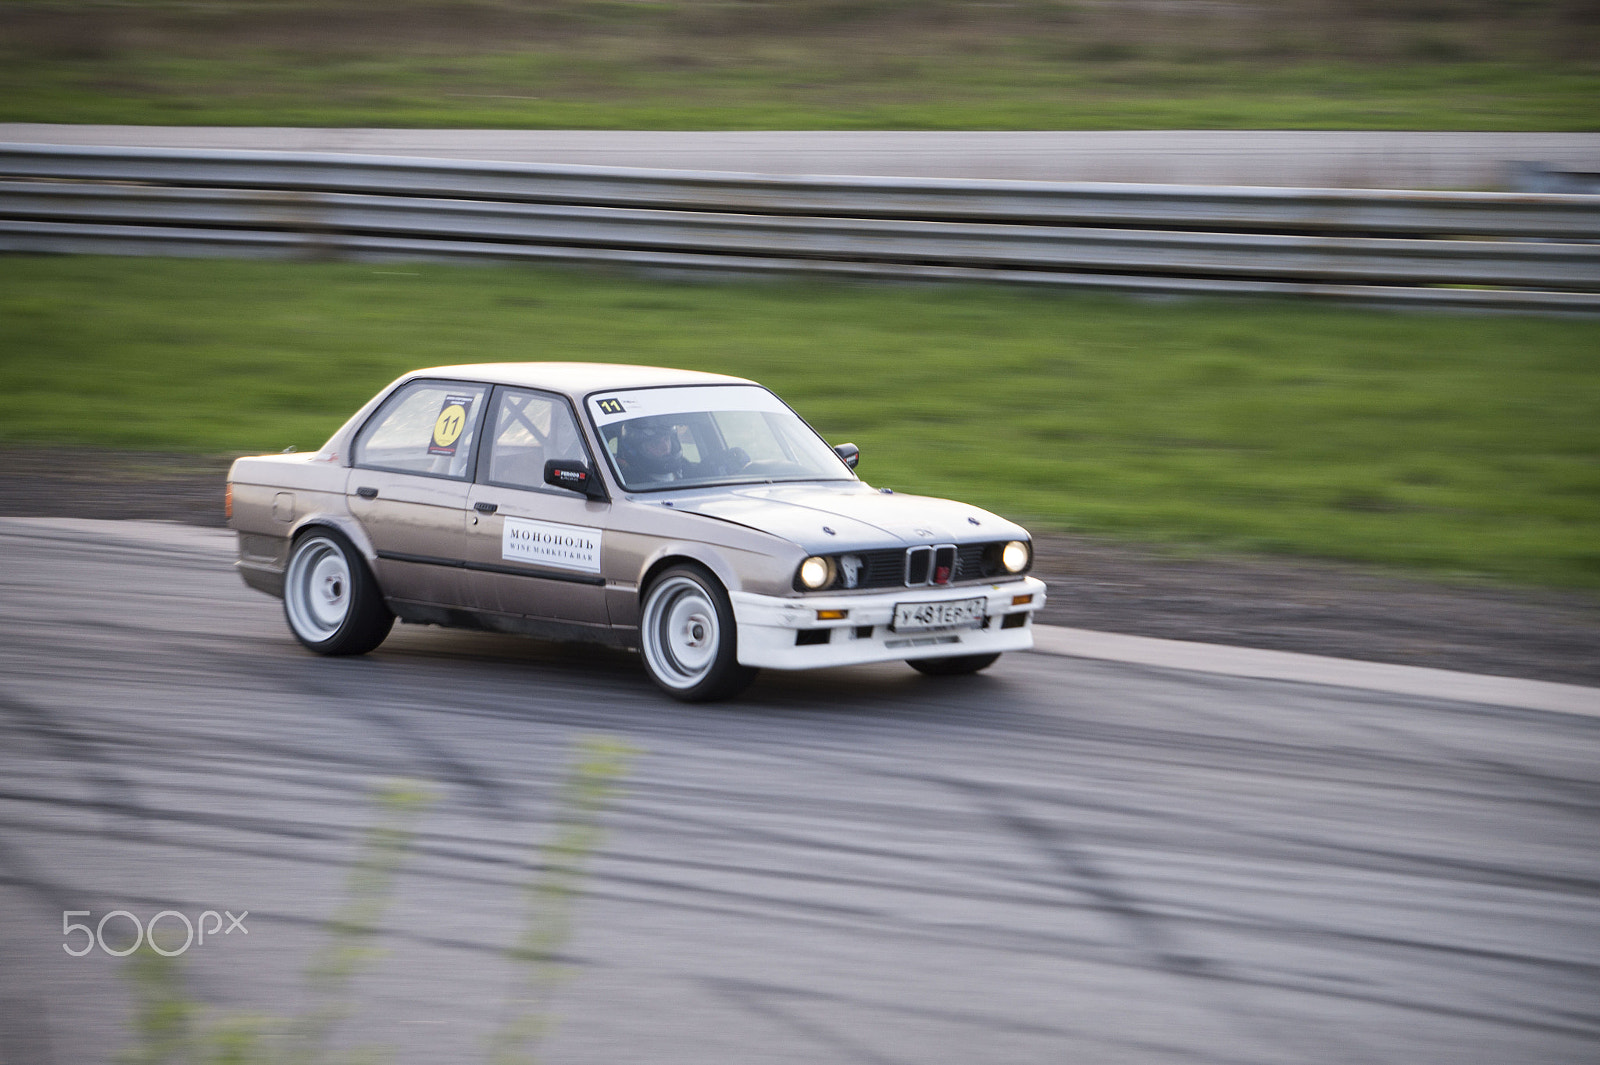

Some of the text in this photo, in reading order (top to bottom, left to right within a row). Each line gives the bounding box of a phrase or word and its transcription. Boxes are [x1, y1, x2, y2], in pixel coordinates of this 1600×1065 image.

[601, 400, 621, 412] 11
[442, 415, 460, 436] 11
[510, 529, 594, 549] МОНОПОЛЬ
[510, 542, 531, 553] WINE
